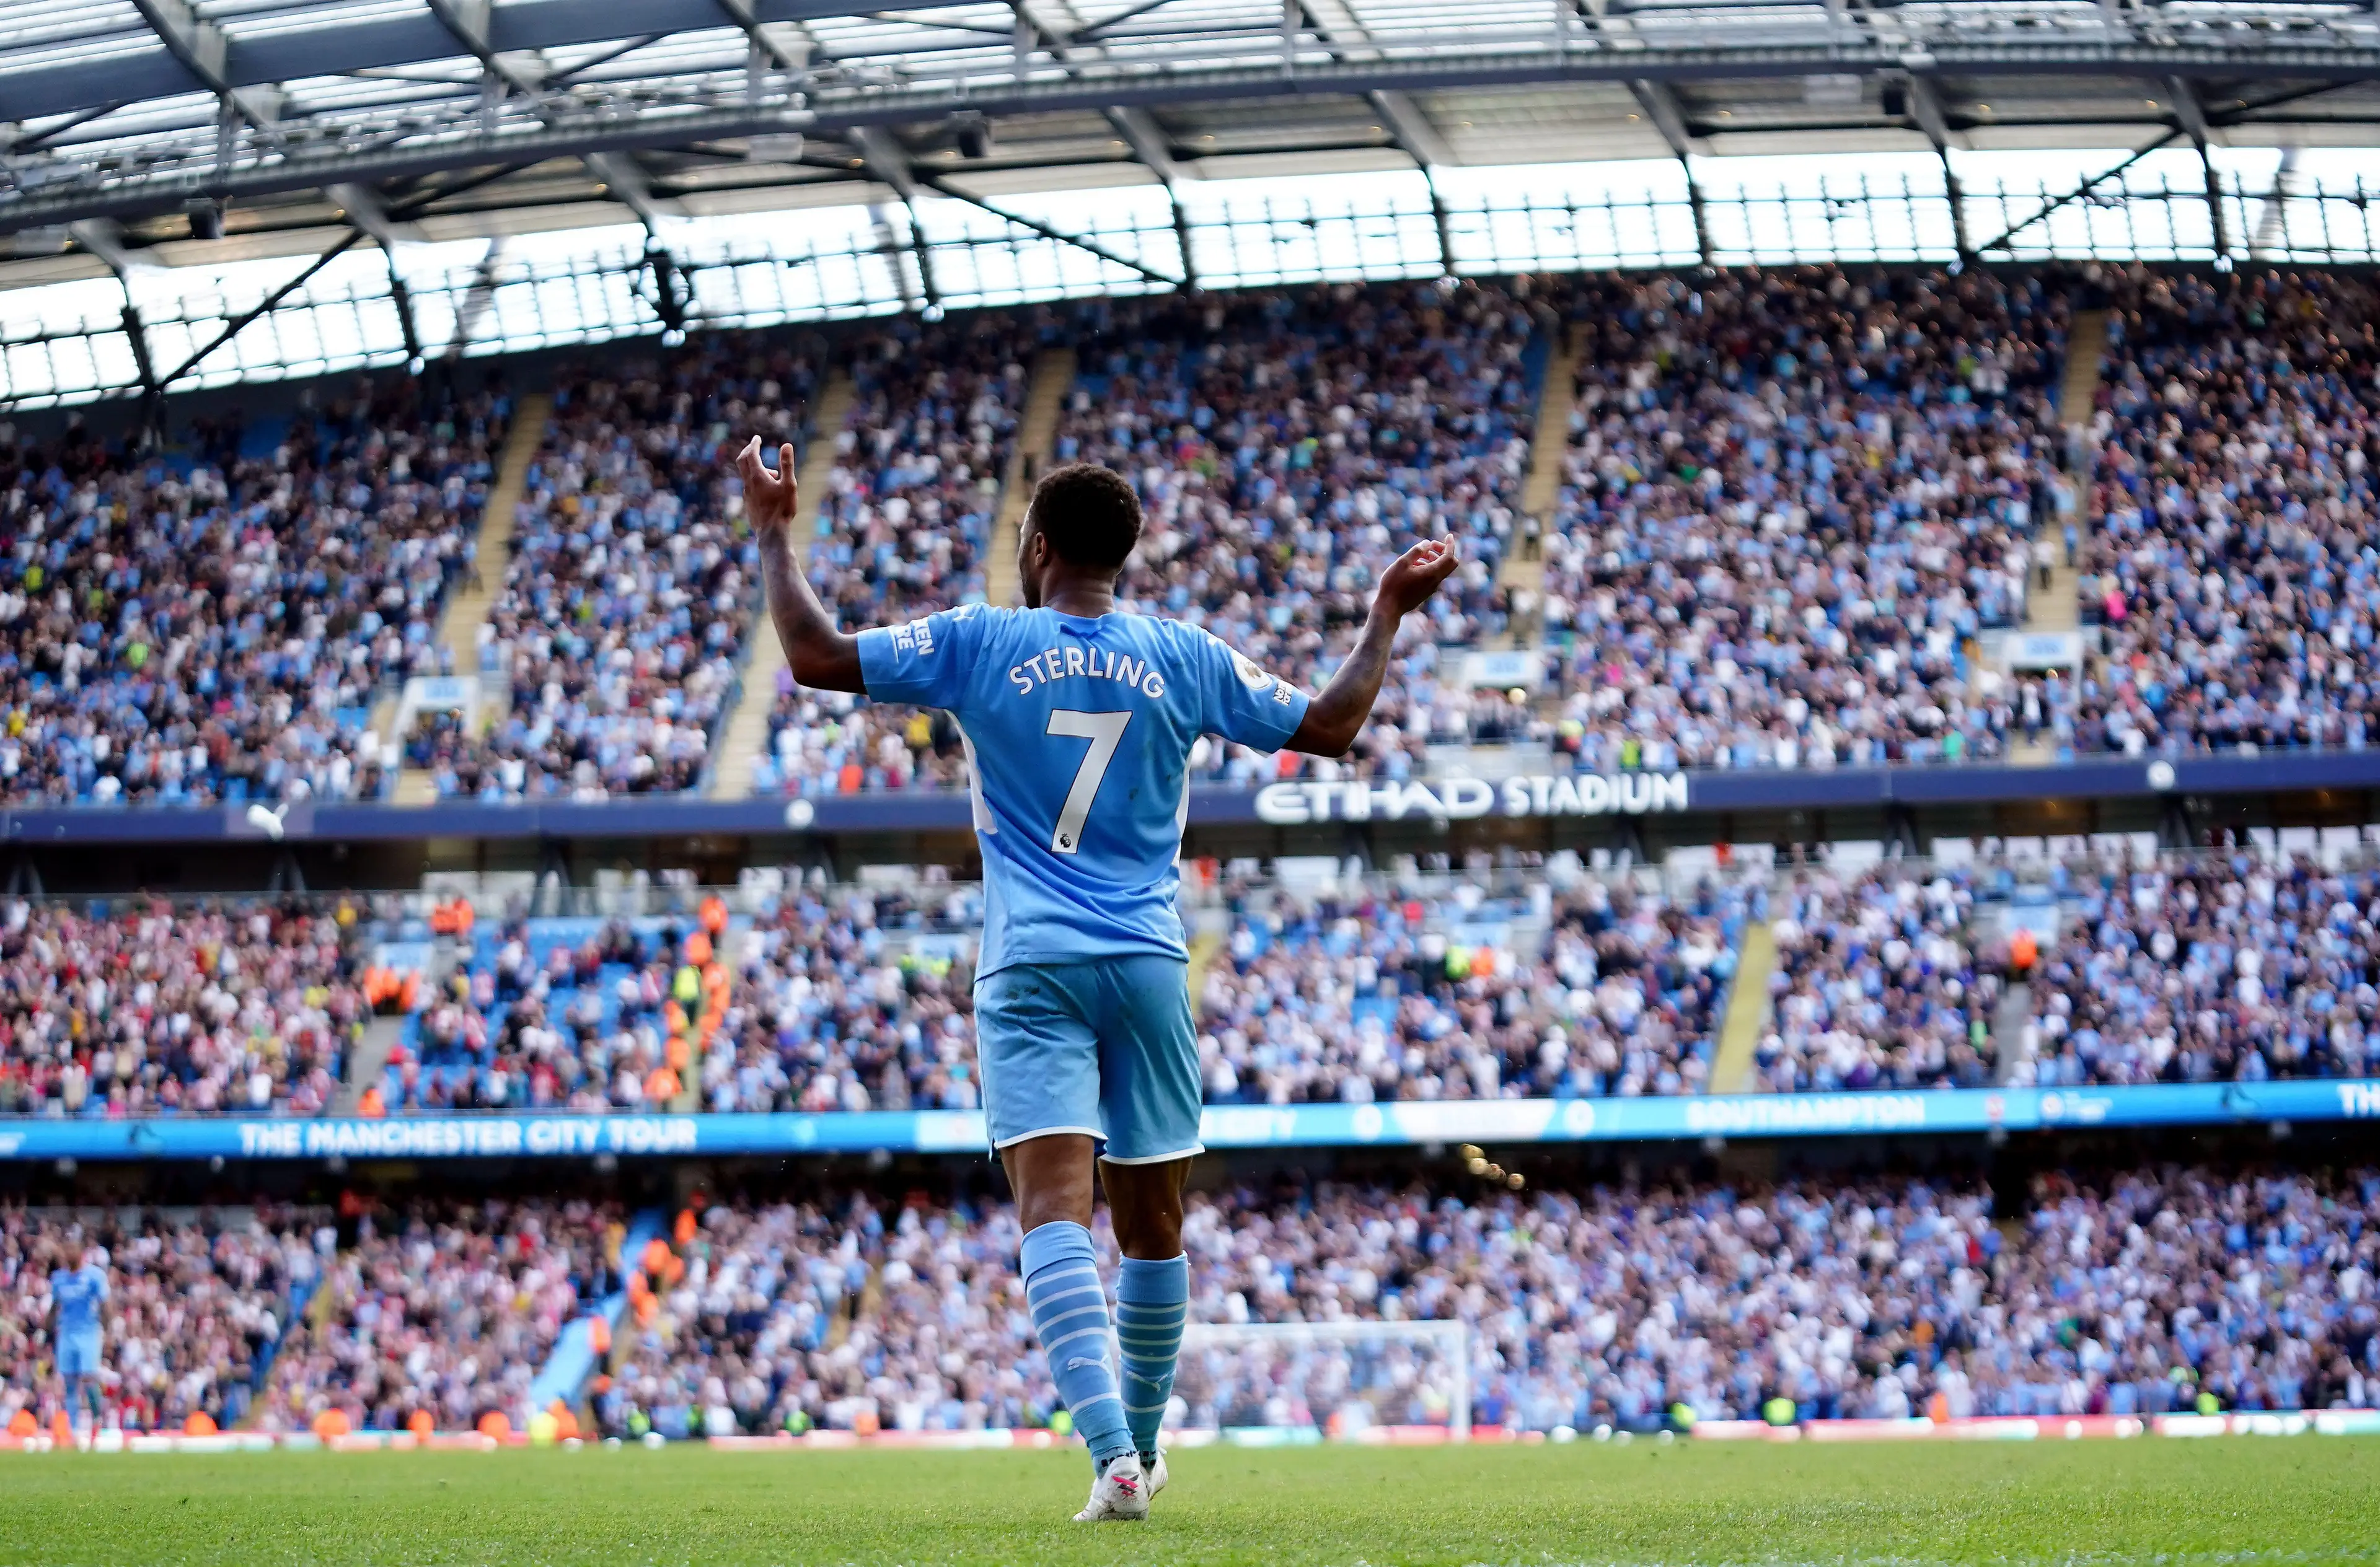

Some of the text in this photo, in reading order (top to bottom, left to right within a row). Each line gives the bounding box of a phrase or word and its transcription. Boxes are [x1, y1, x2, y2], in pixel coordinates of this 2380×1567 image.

[1010, 646, 1165, 698] STERLING
[1046, 708, 1133, 854] 7
[1254, 771, 1688, 823] ETIHAD STADIUM
[240, 1118, 697, 1157] THE MANCHESTER CITY TOUR
[1687, 1095, 1926, 1133] SOUTHAMPTON
